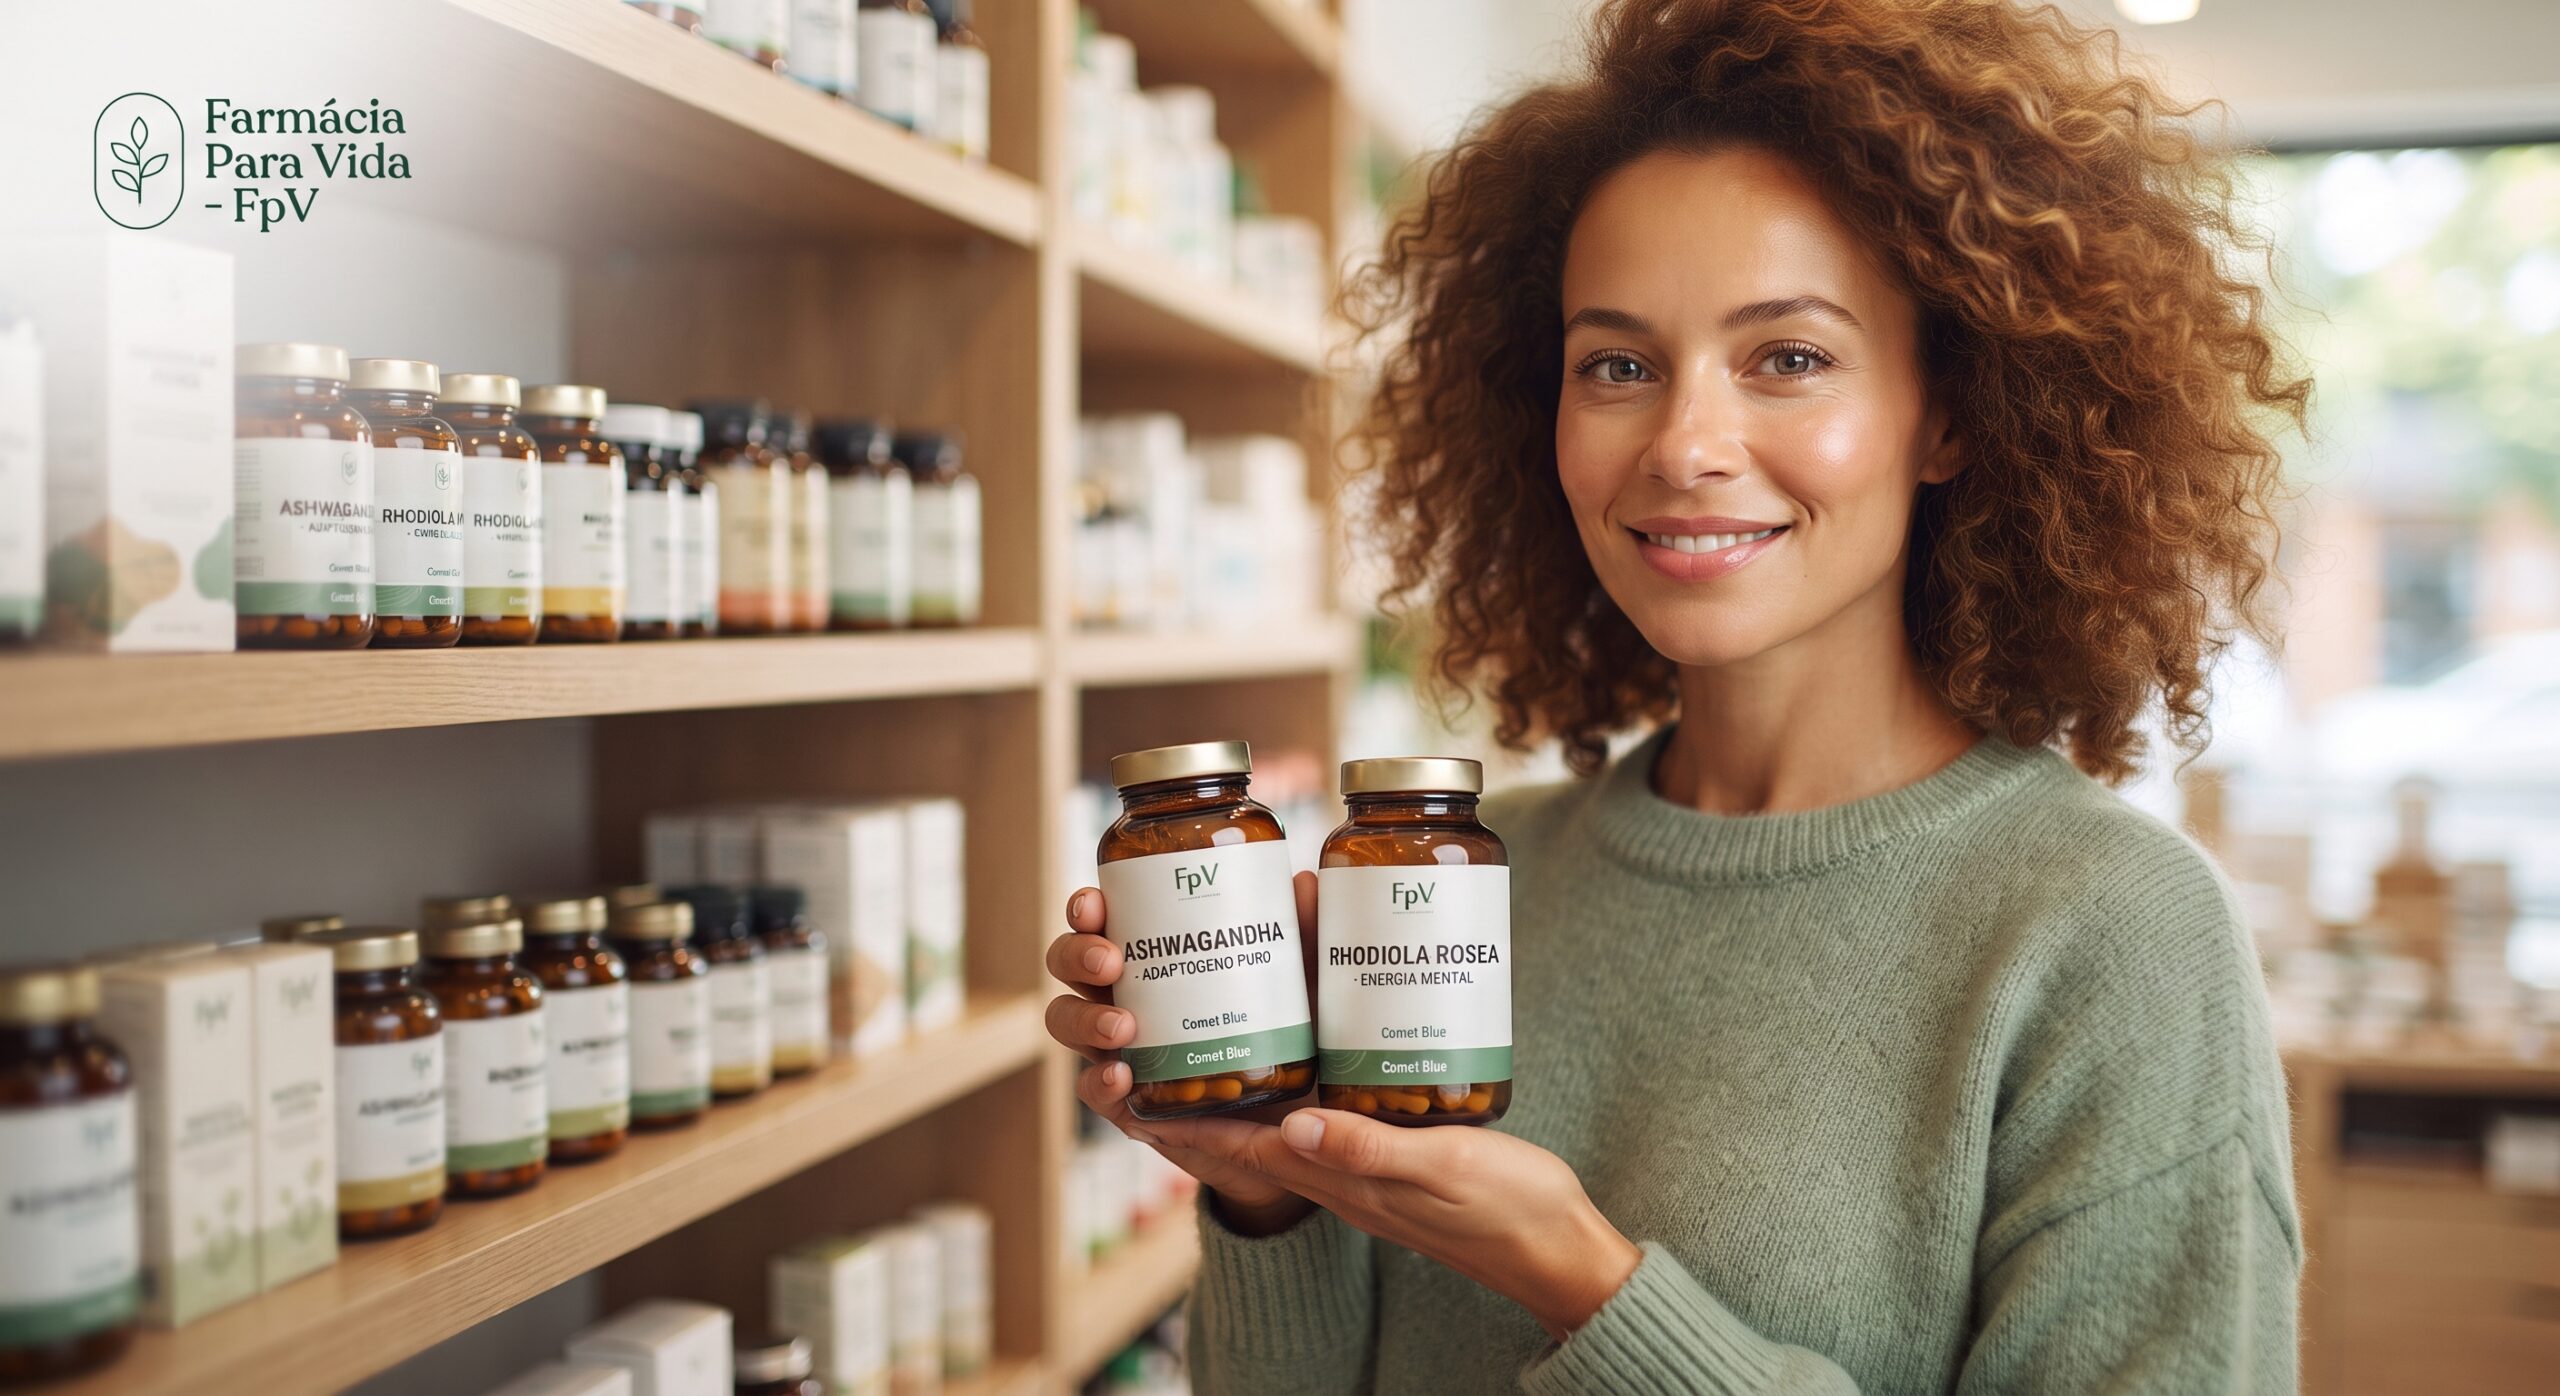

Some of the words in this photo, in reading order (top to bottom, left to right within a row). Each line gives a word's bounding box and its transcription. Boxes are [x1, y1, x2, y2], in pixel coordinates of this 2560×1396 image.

[382, 508, 455, 525] RHODIOLA
[1174, 862, 1219, 895] FpV
[1392, 881, 1436, 910] FpV
[1124, 921, 1285, 963] ASHWAGANDHA
[1329, 945, 1430, 966] RHODIOLA
[1436, 944, 1500, 965] ROSEA
[1142, 956, 1235, 981] ADAPTOGENO
[1237, 950, 1272, 967] PURO
[1360, 972, 1418, 986] ENERGIA
[1421, 971, 1475, 985] MENTAL
[1182, 1015, 1220, 1030] Comet
[1223, 1011, 1248, 1025] Blue
[1381, 1026, 1419, 1039] Comet
[1421, 1025, 1447, 1038] Blue
[1186, 1049, 1224, 1065] Comet
[1226, 1046, 1252, 1060] Blue
[1381, 1060, 1420, 1074] Comet
[1422, 1059, 1448, 1073] Blue
